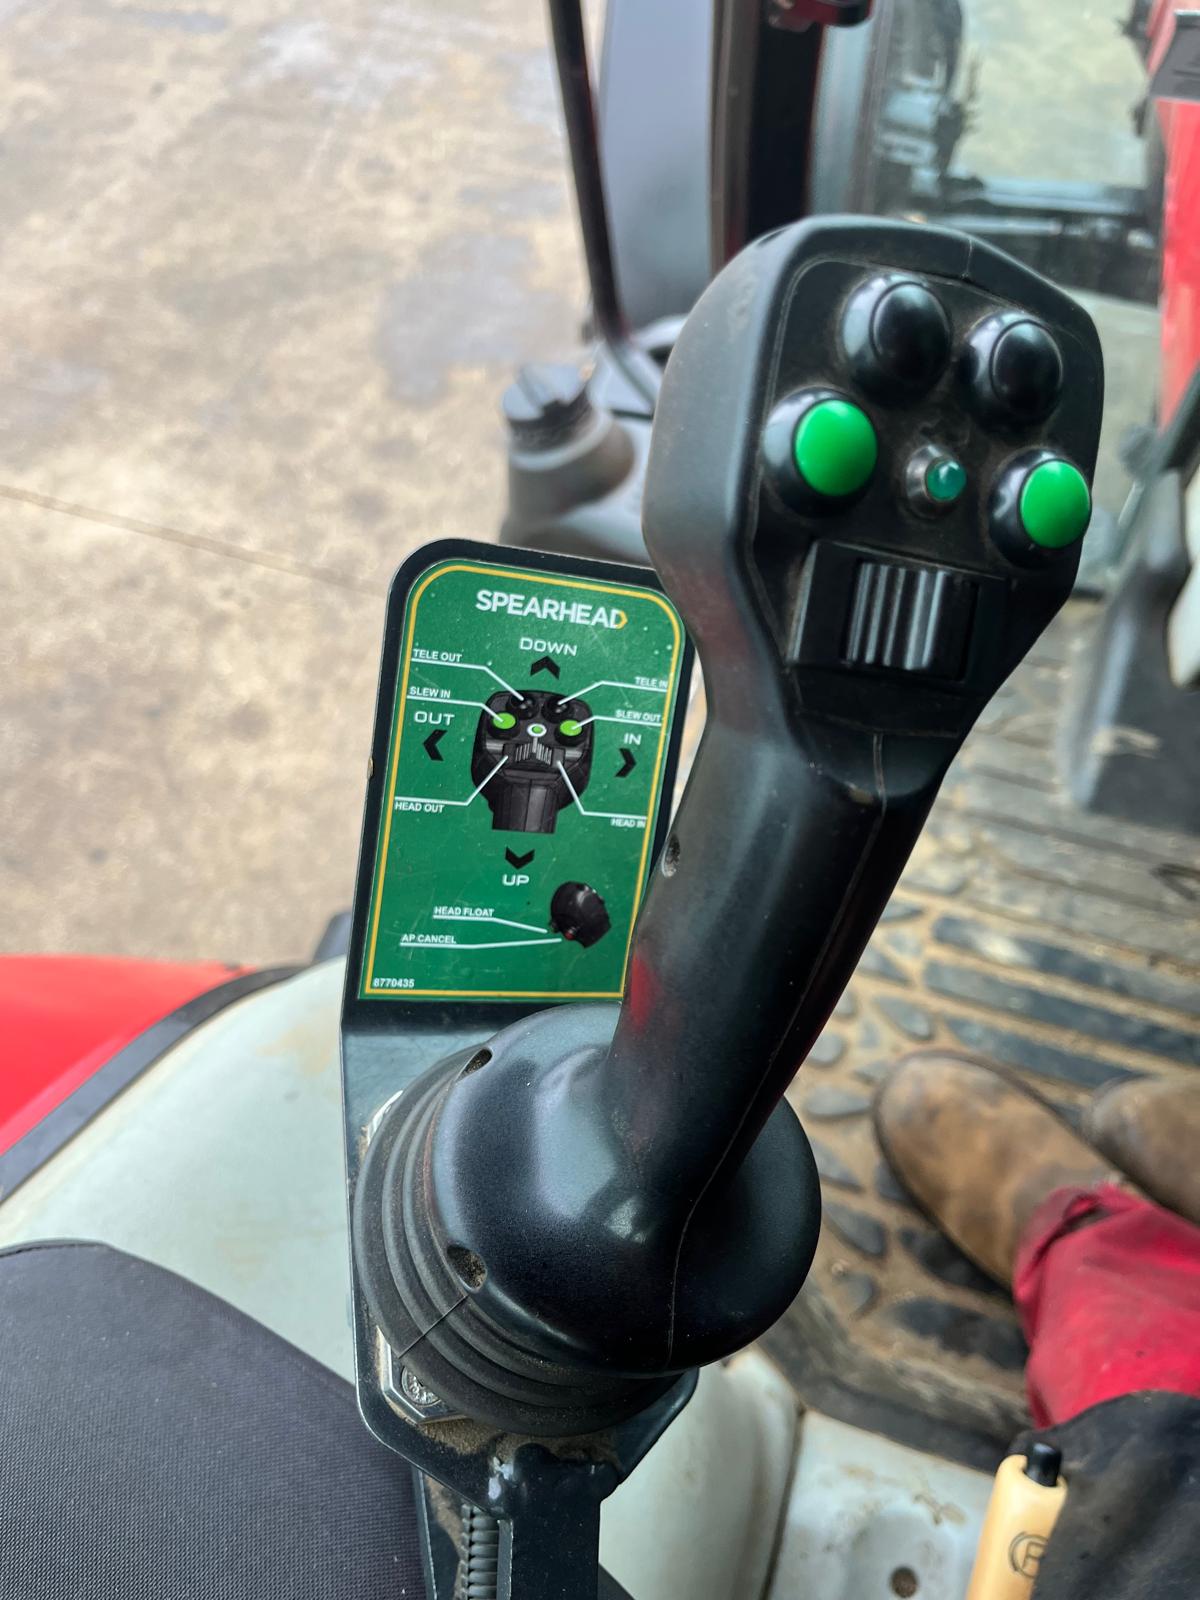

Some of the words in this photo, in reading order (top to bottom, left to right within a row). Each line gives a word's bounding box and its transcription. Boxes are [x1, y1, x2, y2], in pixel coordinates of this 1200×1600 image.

[476, 589, 627, 629] SPEARHEAD
[519, 637, 577, 656] DOWN
[413, 649, 438, 661] TELE
[440, 652, 462, 662] OUT
[635, 676, 657, 687] TELE
[658, 679, 668, 688] IN
[409, 686, 439, 697] SLEW
[440, 689, 450, 698] IN
[414, 710, 454, 725] OUT
[615, 709, 640, 720] SLEW
[641, 712, 661, 722] OUT
[624, 733, 641, 745] IN
[395, 801, 421, 813] HEAD
[423, 803, 444, 814] OUT
[611, 818, 634, 827] HEAD
[636, 819, 645, 828] IN
[503, 874, 529, 886] UP
[434, 906, 462, 916] HEAD
[463, 908, 494, 917] FLOAT
[401, 933, 415, 943] AP
[417, 934, 456, 944] CANCEL
[373, 978, 414, 988] 8770435
